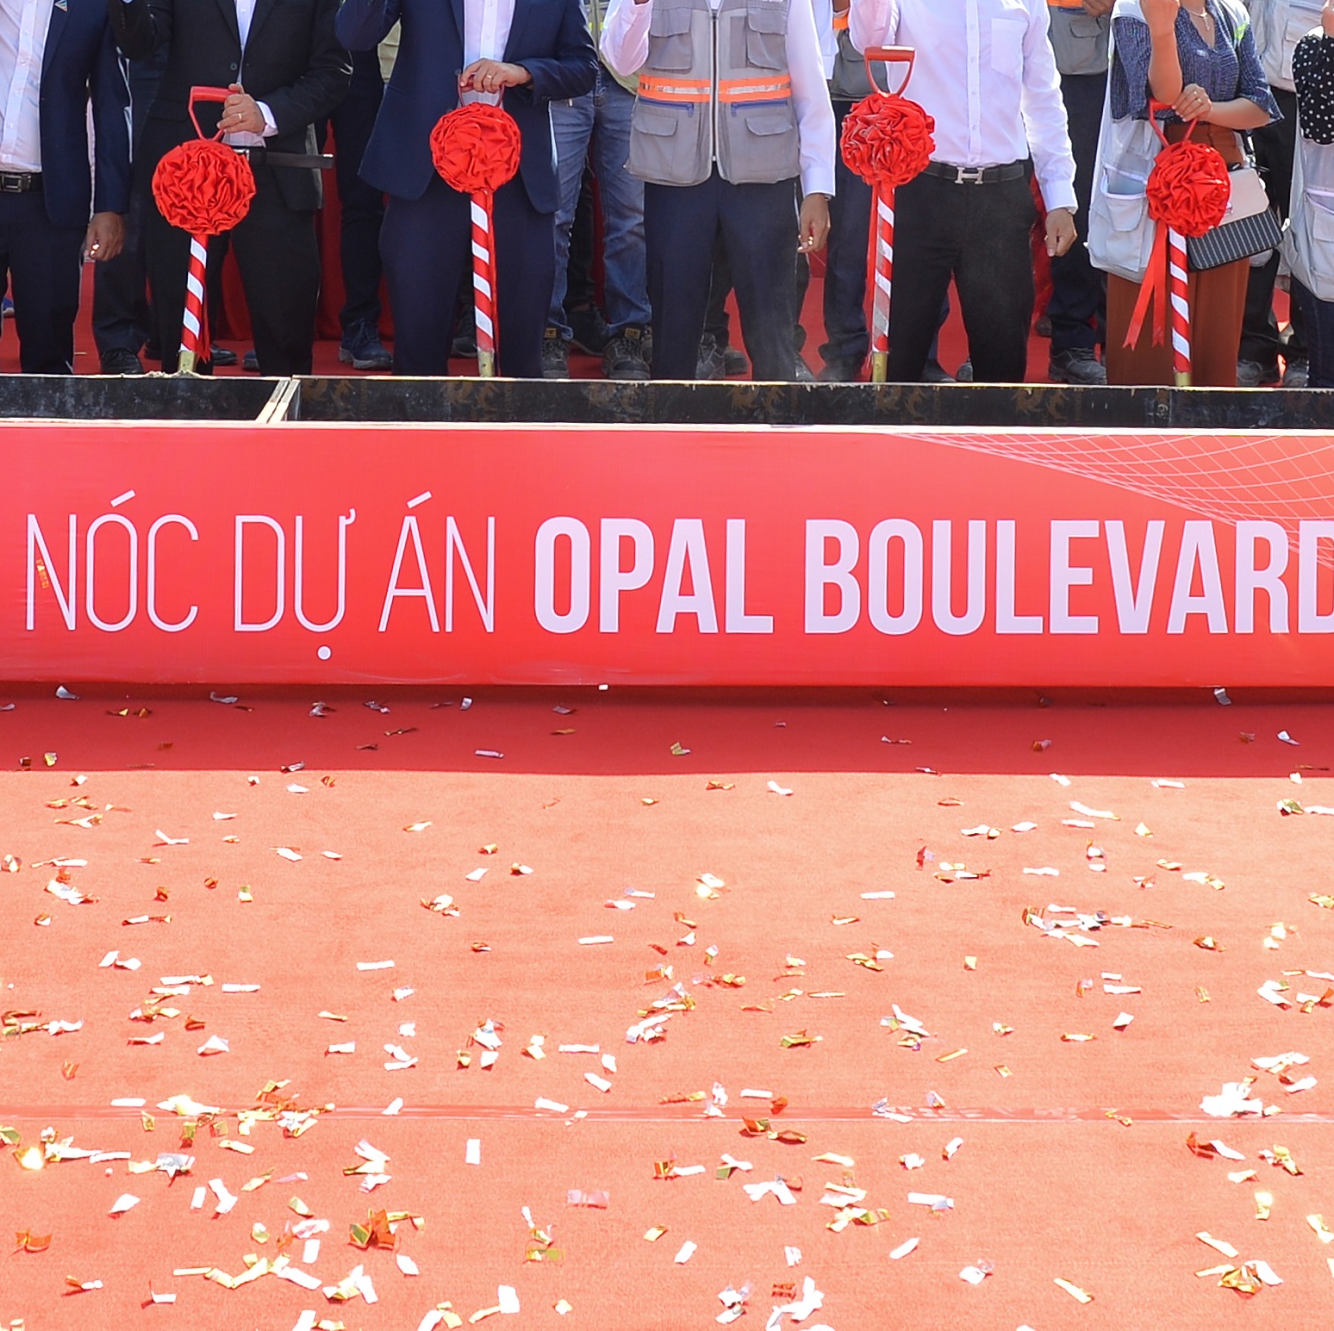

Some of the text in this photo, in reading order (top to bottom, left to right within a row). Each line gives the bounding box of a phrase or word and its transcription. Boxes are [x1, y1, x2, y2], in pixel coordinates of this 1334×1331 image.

[26, 489, 199, 633] NÓC
[234, 507, 357, 661] DỰ
[379, 490, 495, 633] ÁN
[534, 516, 774, 634] OPAL
